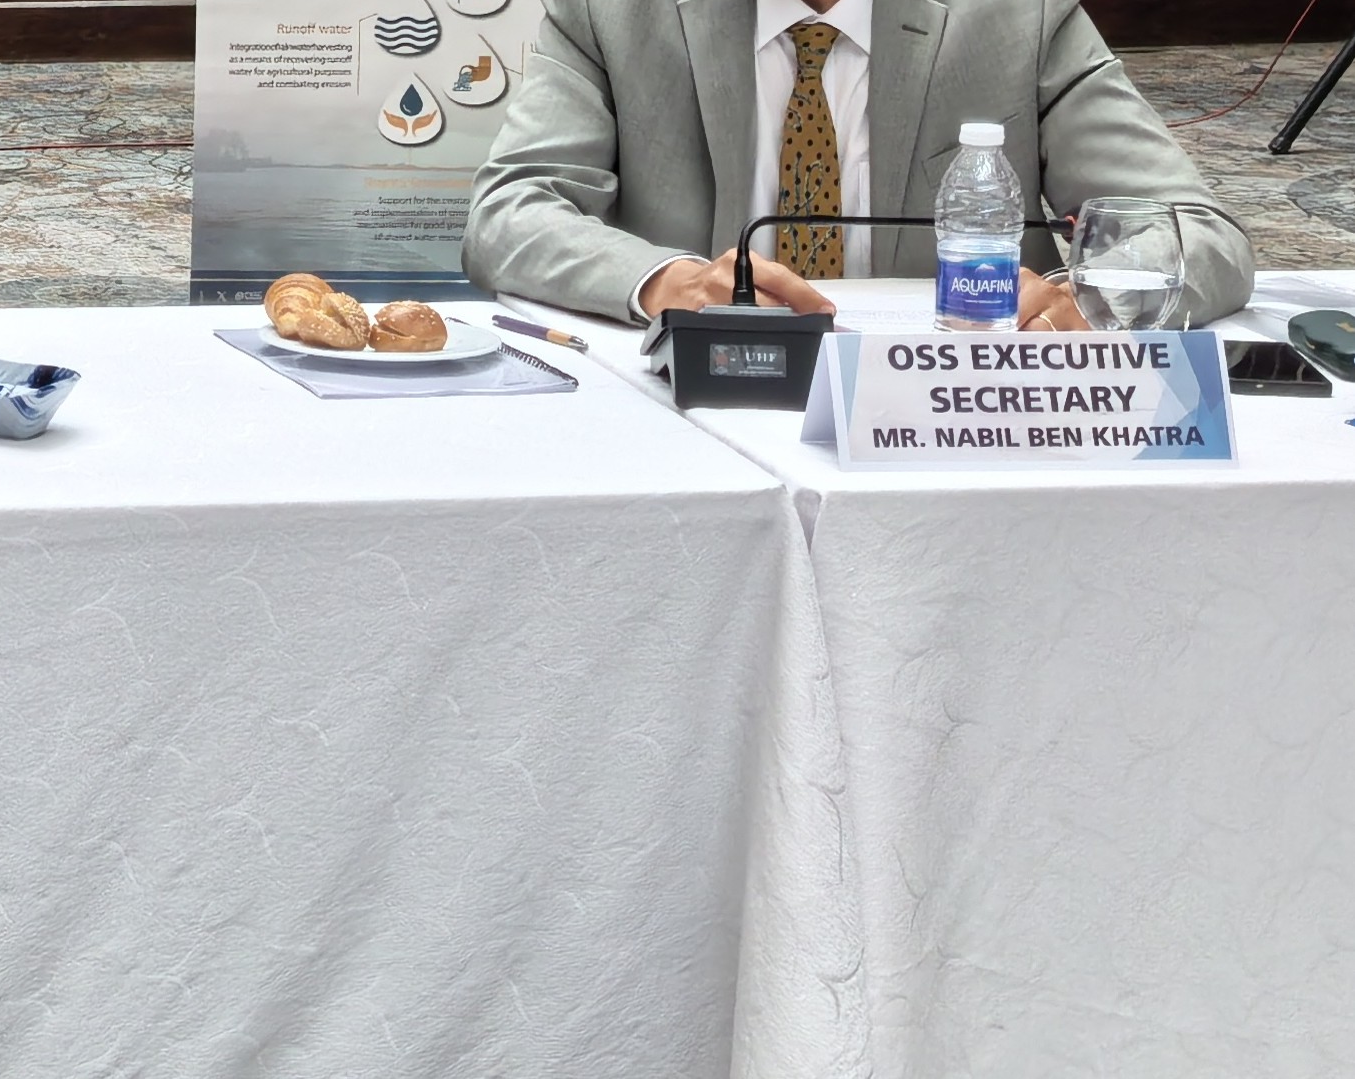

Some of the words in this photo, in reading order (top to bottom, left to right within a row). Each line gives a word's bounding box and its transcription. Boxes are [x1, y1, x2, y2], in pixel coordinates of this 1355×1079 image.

[277, 23, 316, 34] Runoff
[319, 25, 352, 34] water
[951, 277, 1013, 296] AQUAFINA
[746, 352, 777, 362] UHF
[887, 344, 958, 371] OSS
[972, 343, 1171, 371] EXECUTIVE
[930, 386, 1136, 413] SECRETARY
[873, 428, 926, 448] MR.
[936, 428, 1019, 448] NABIL
[1029, 427, 1083, 447] BEN
[1092, 425, 1205, 447] KHATRA
